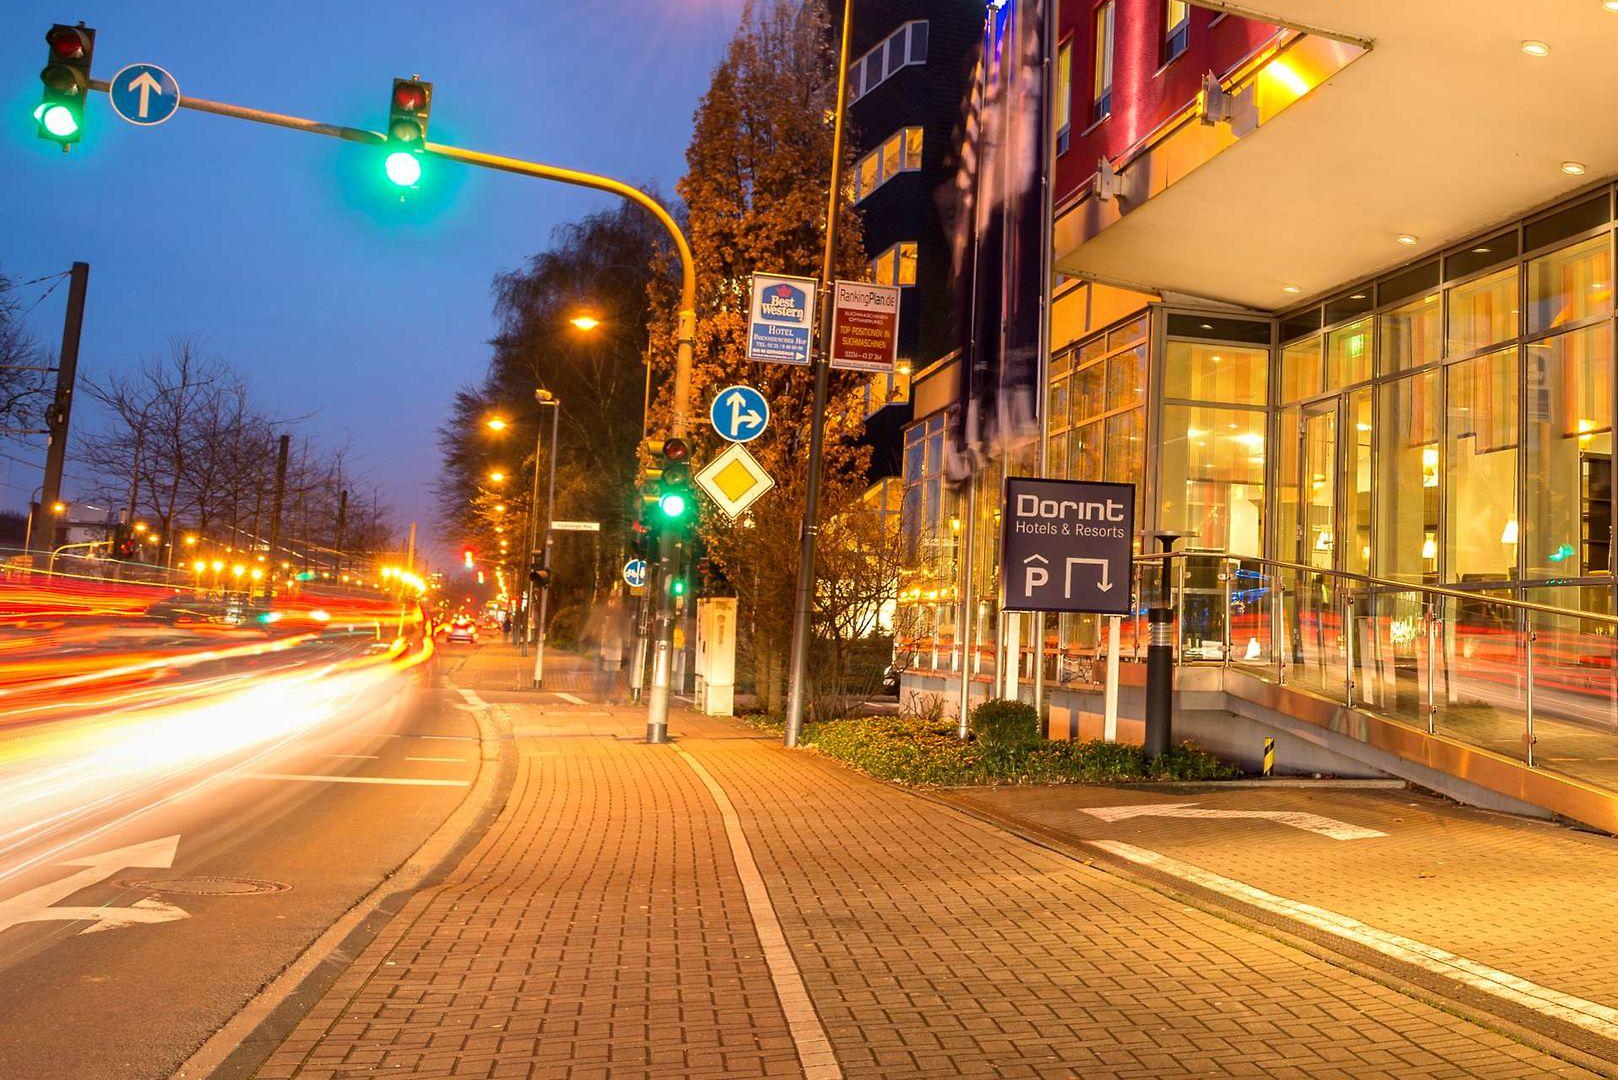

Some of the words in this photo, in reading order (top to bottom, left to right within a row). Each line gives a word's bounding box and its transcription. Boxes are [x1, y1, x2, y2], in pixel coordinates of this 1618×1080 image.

[771, 295, 795, 307] Best
[840, 288, 895, 307] RankingPlan.de
[762, 302, 804, 319] Western
[840, 325, 850, 334] TOP
[1016, 494, 1125, 522] Dorint
[1016, 521, 1058, 535] Hotels
[1062, 524, 1070, 535] &
[1075, 524, 1125, 538] Resorts
[1025, 567, 1049, 597] P
